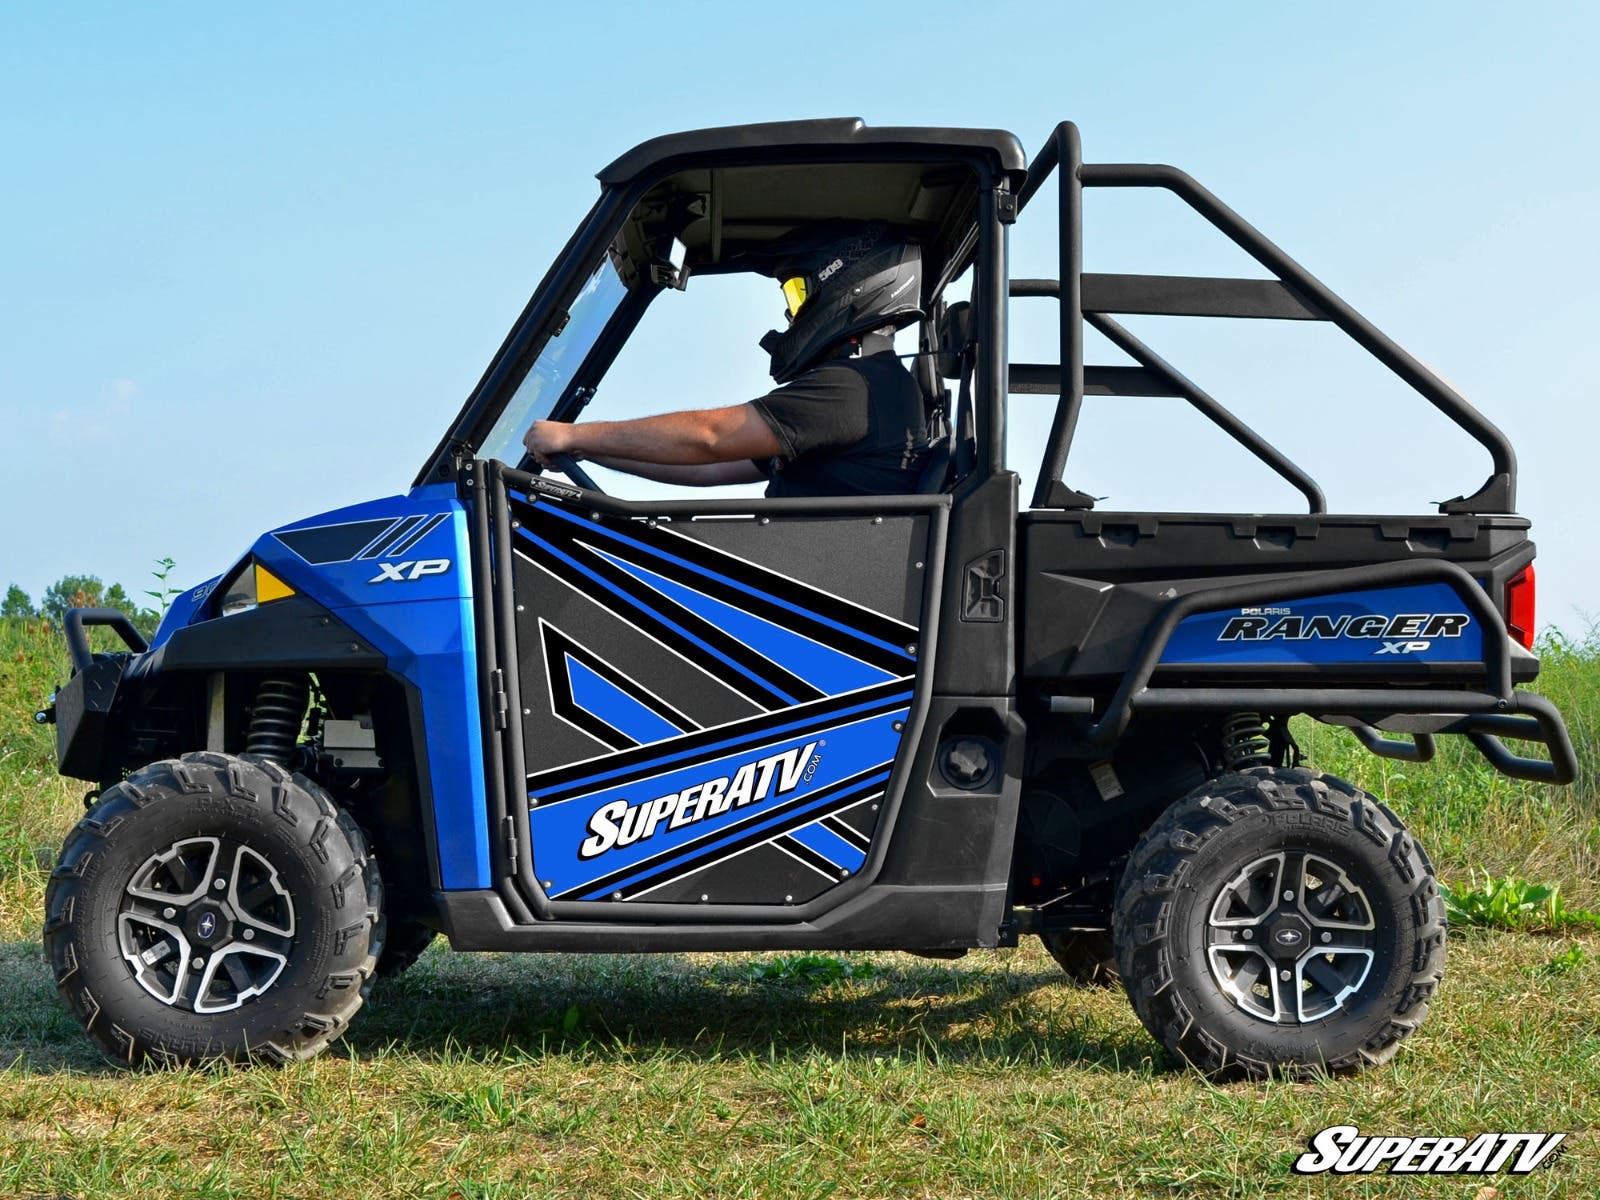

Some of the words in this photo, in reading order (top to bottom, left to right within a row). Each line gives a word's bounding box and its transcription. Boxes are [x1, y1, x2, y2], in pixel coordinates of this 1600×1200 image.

[367, 558, 451, 583] XP
[1241, 607, 1291, 616] POLARIS
[1217, 613, 1471, 641] RANGER
[1373, 641, 1431, 655] XP
[577, 741, 818, 861] SUPERATV
